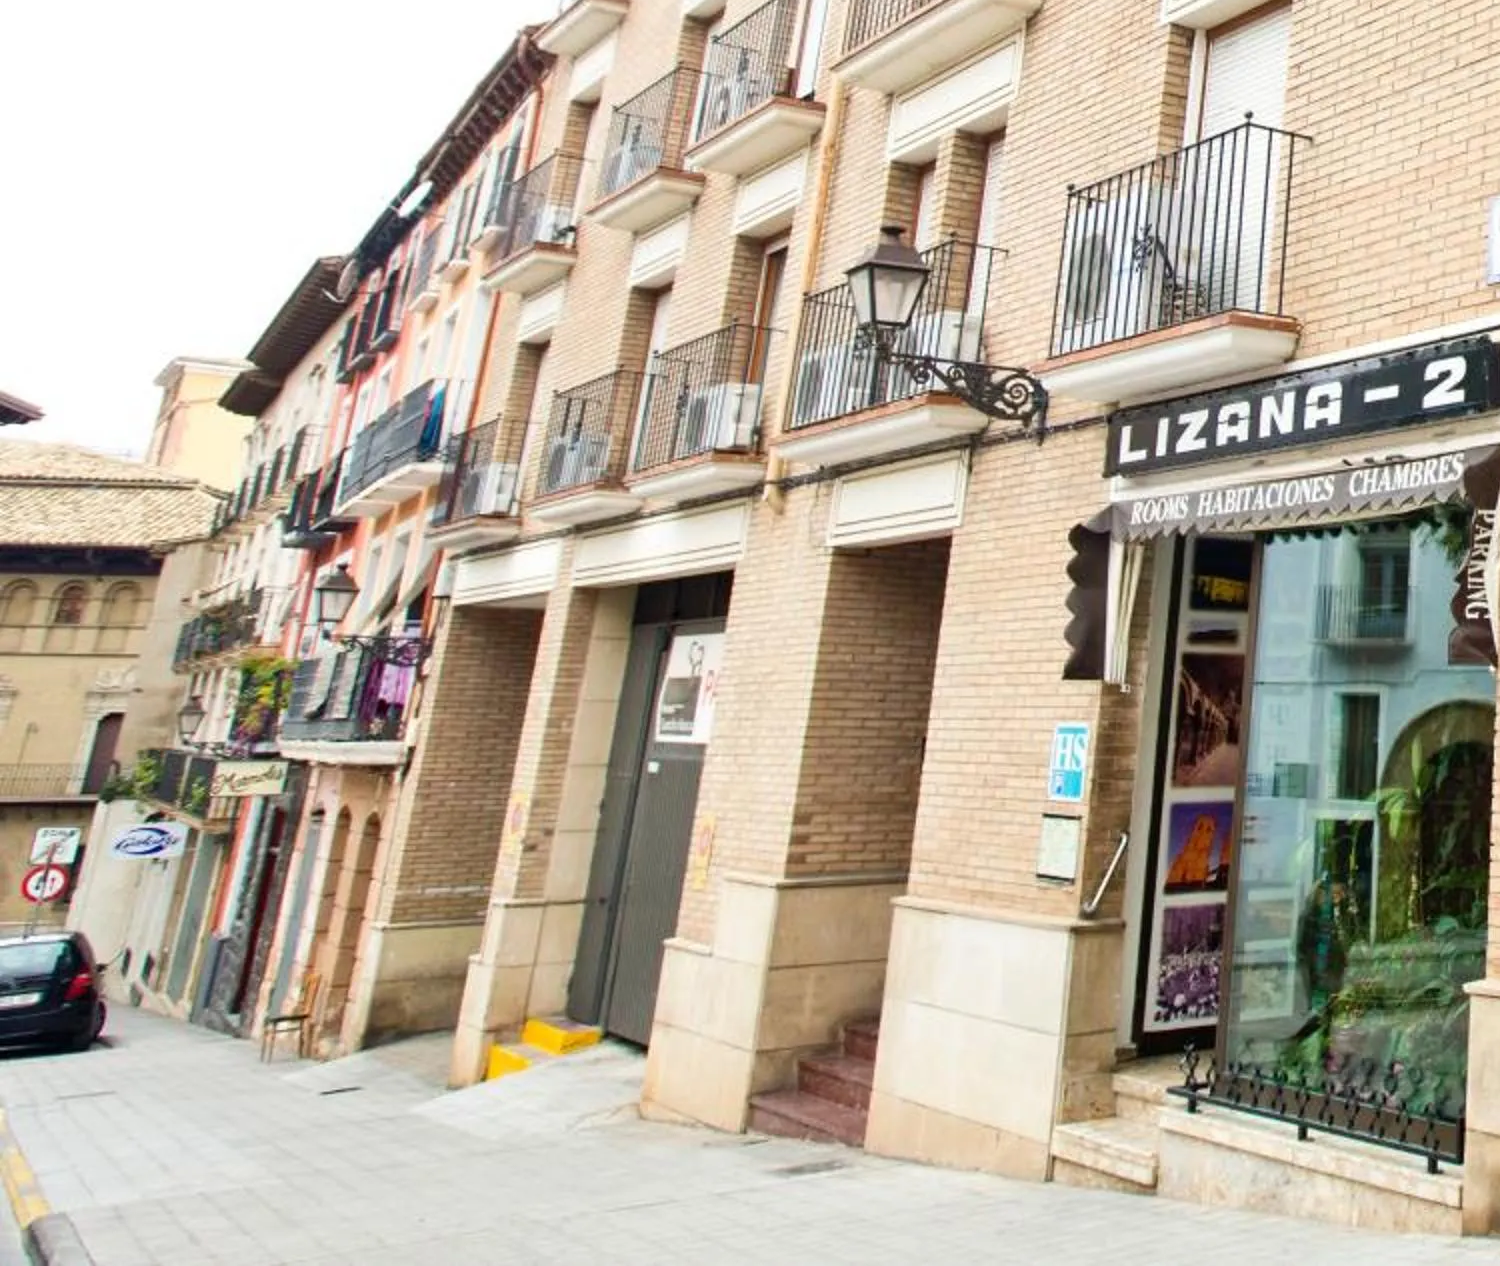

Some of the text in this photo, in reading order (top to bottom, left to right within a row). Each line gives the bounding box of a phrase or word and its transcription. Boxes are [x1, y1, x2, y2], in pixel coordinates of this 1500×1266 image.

[1119, 382, 1343, 464] LIZANA
[1422, 355, 1468, 409] 2
[1131, 452, 1465, 525] ROOMS HABITACIONES CHAMBRES
[1464, 508, 1498, 619] PARKING
